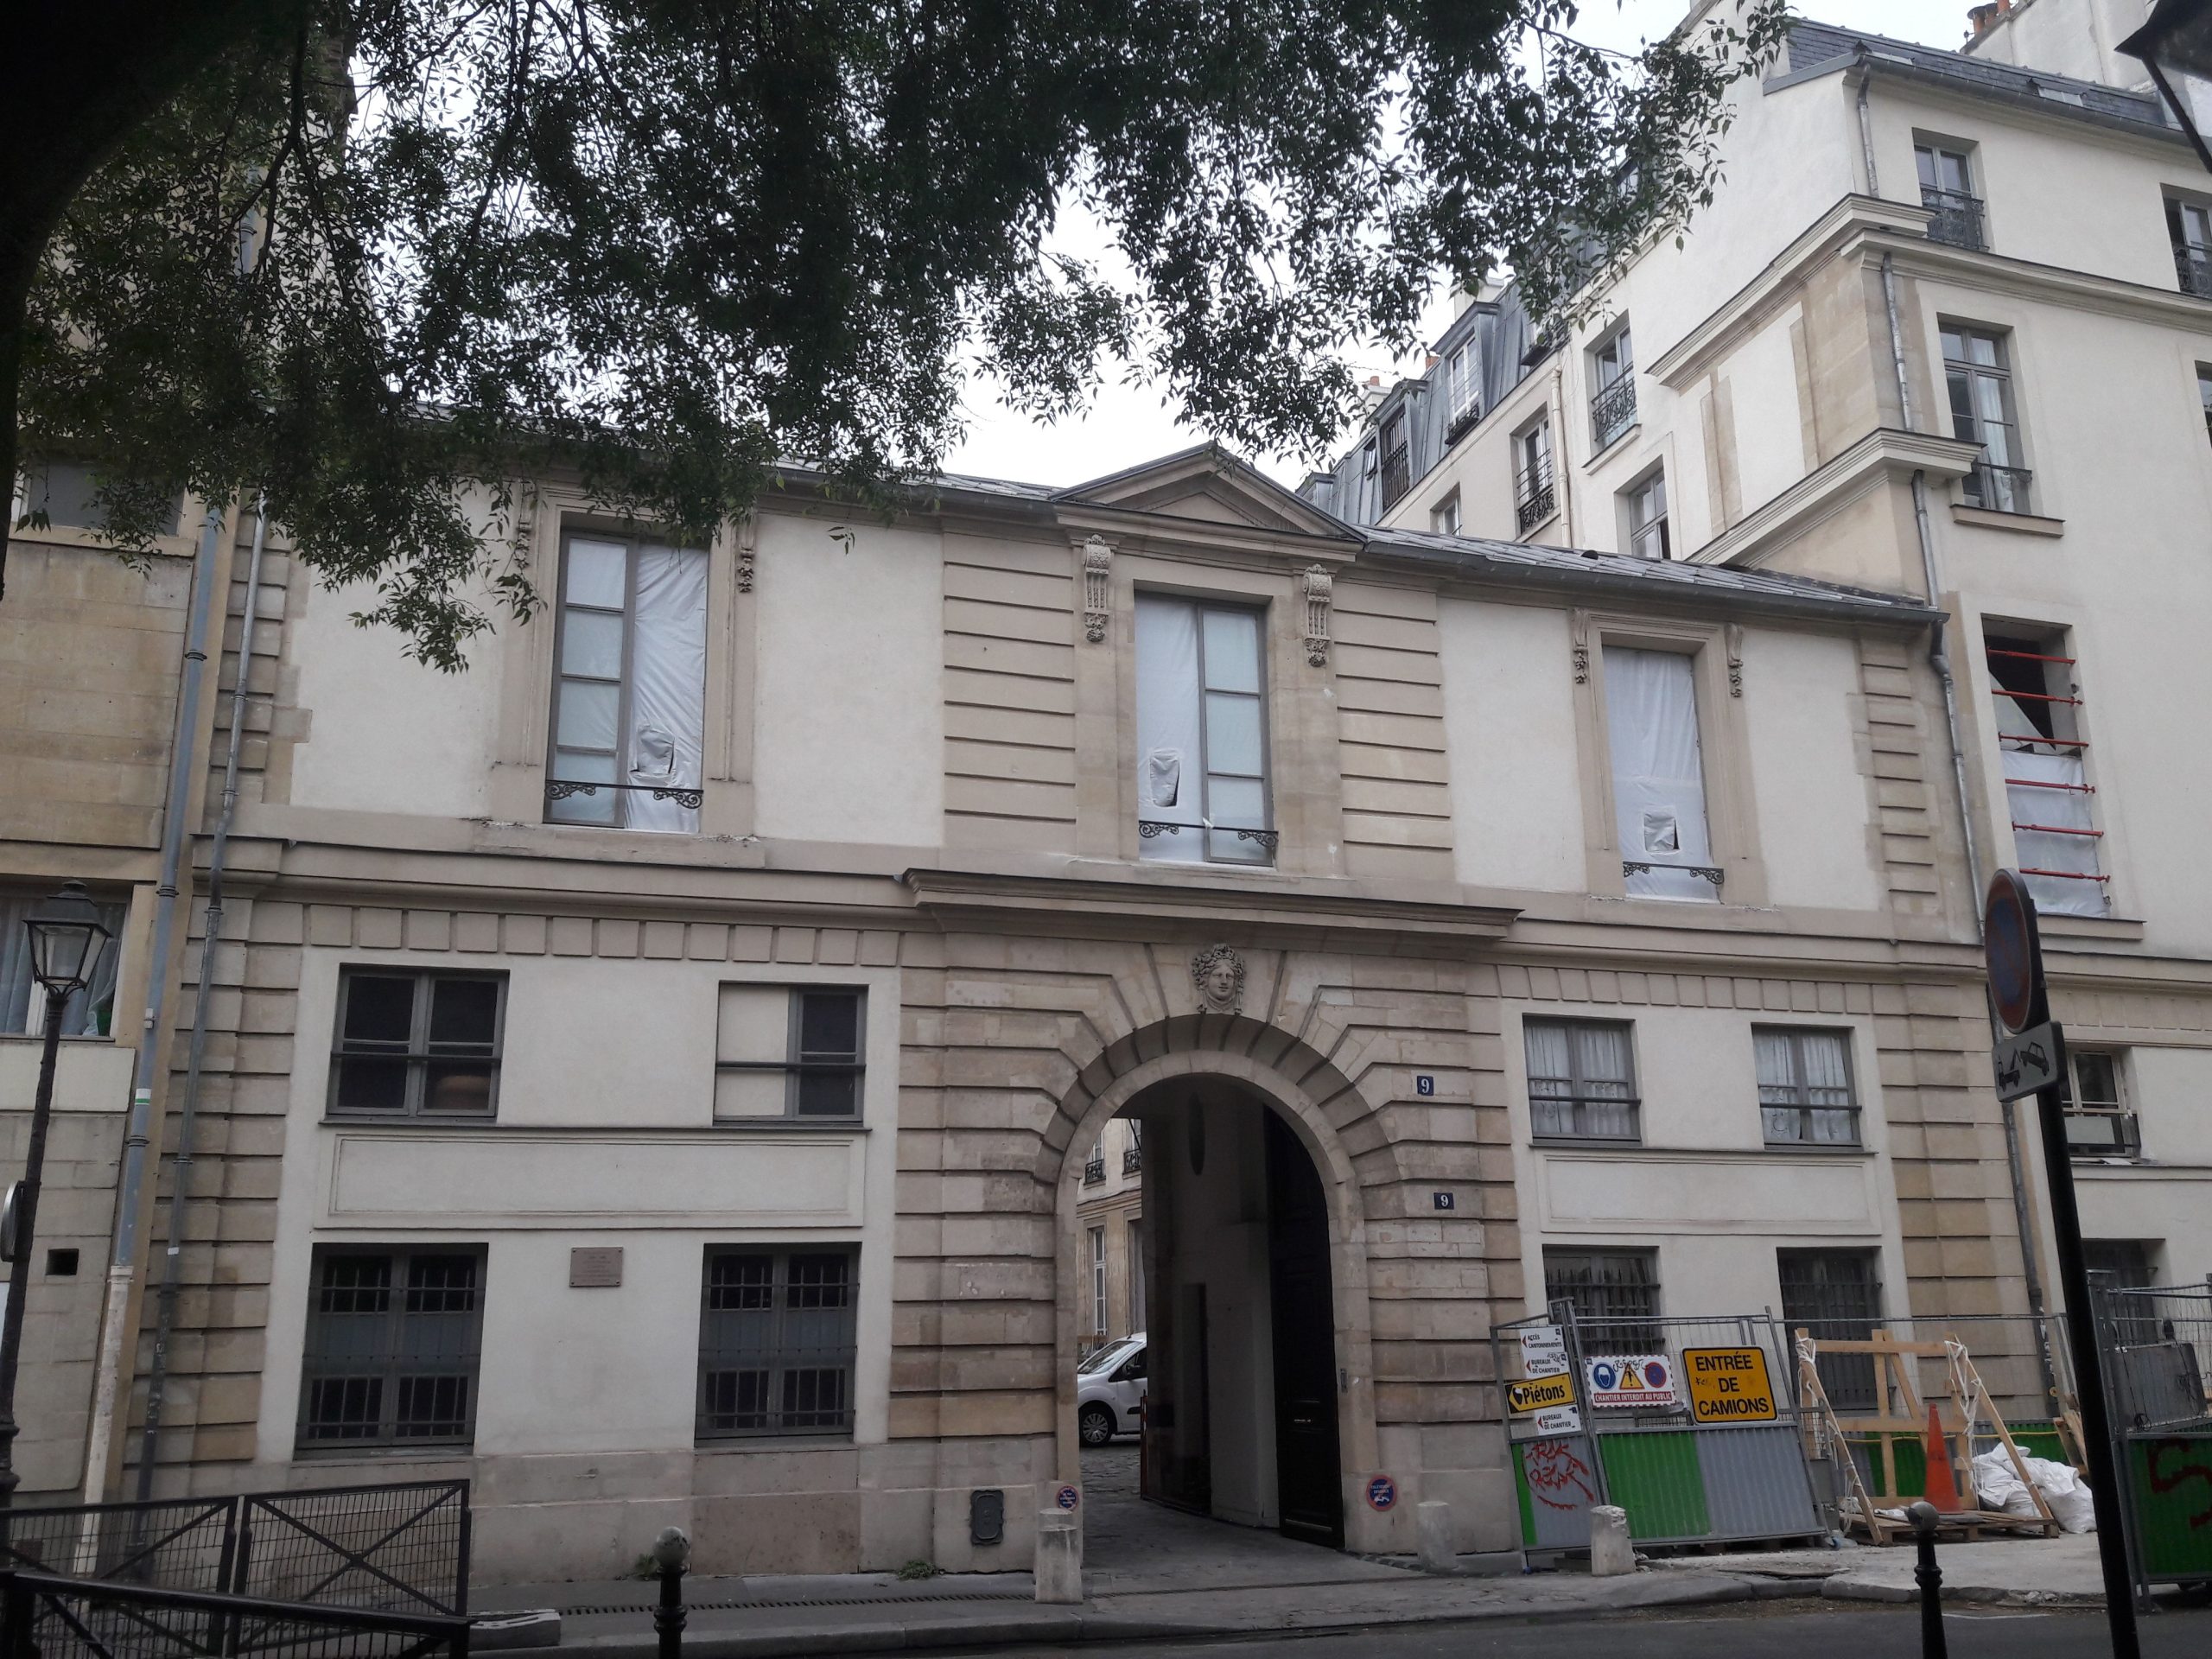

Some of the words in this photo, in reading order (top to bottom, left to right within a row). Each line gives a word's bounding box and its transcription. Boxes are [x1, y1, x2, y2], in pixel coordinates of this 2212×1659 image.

[1421, 1078, 1430, 1094] 9
[1440, 1195, 1449, 1206] 9
[1695, 1351, 1753, 1371] ENTRÉE
[1718, 1377, 1740, 1393] DE
[1522, 1384, 1565, 1404] Piétons
[1699, 1397, 1769, 1415] CAMIONS
